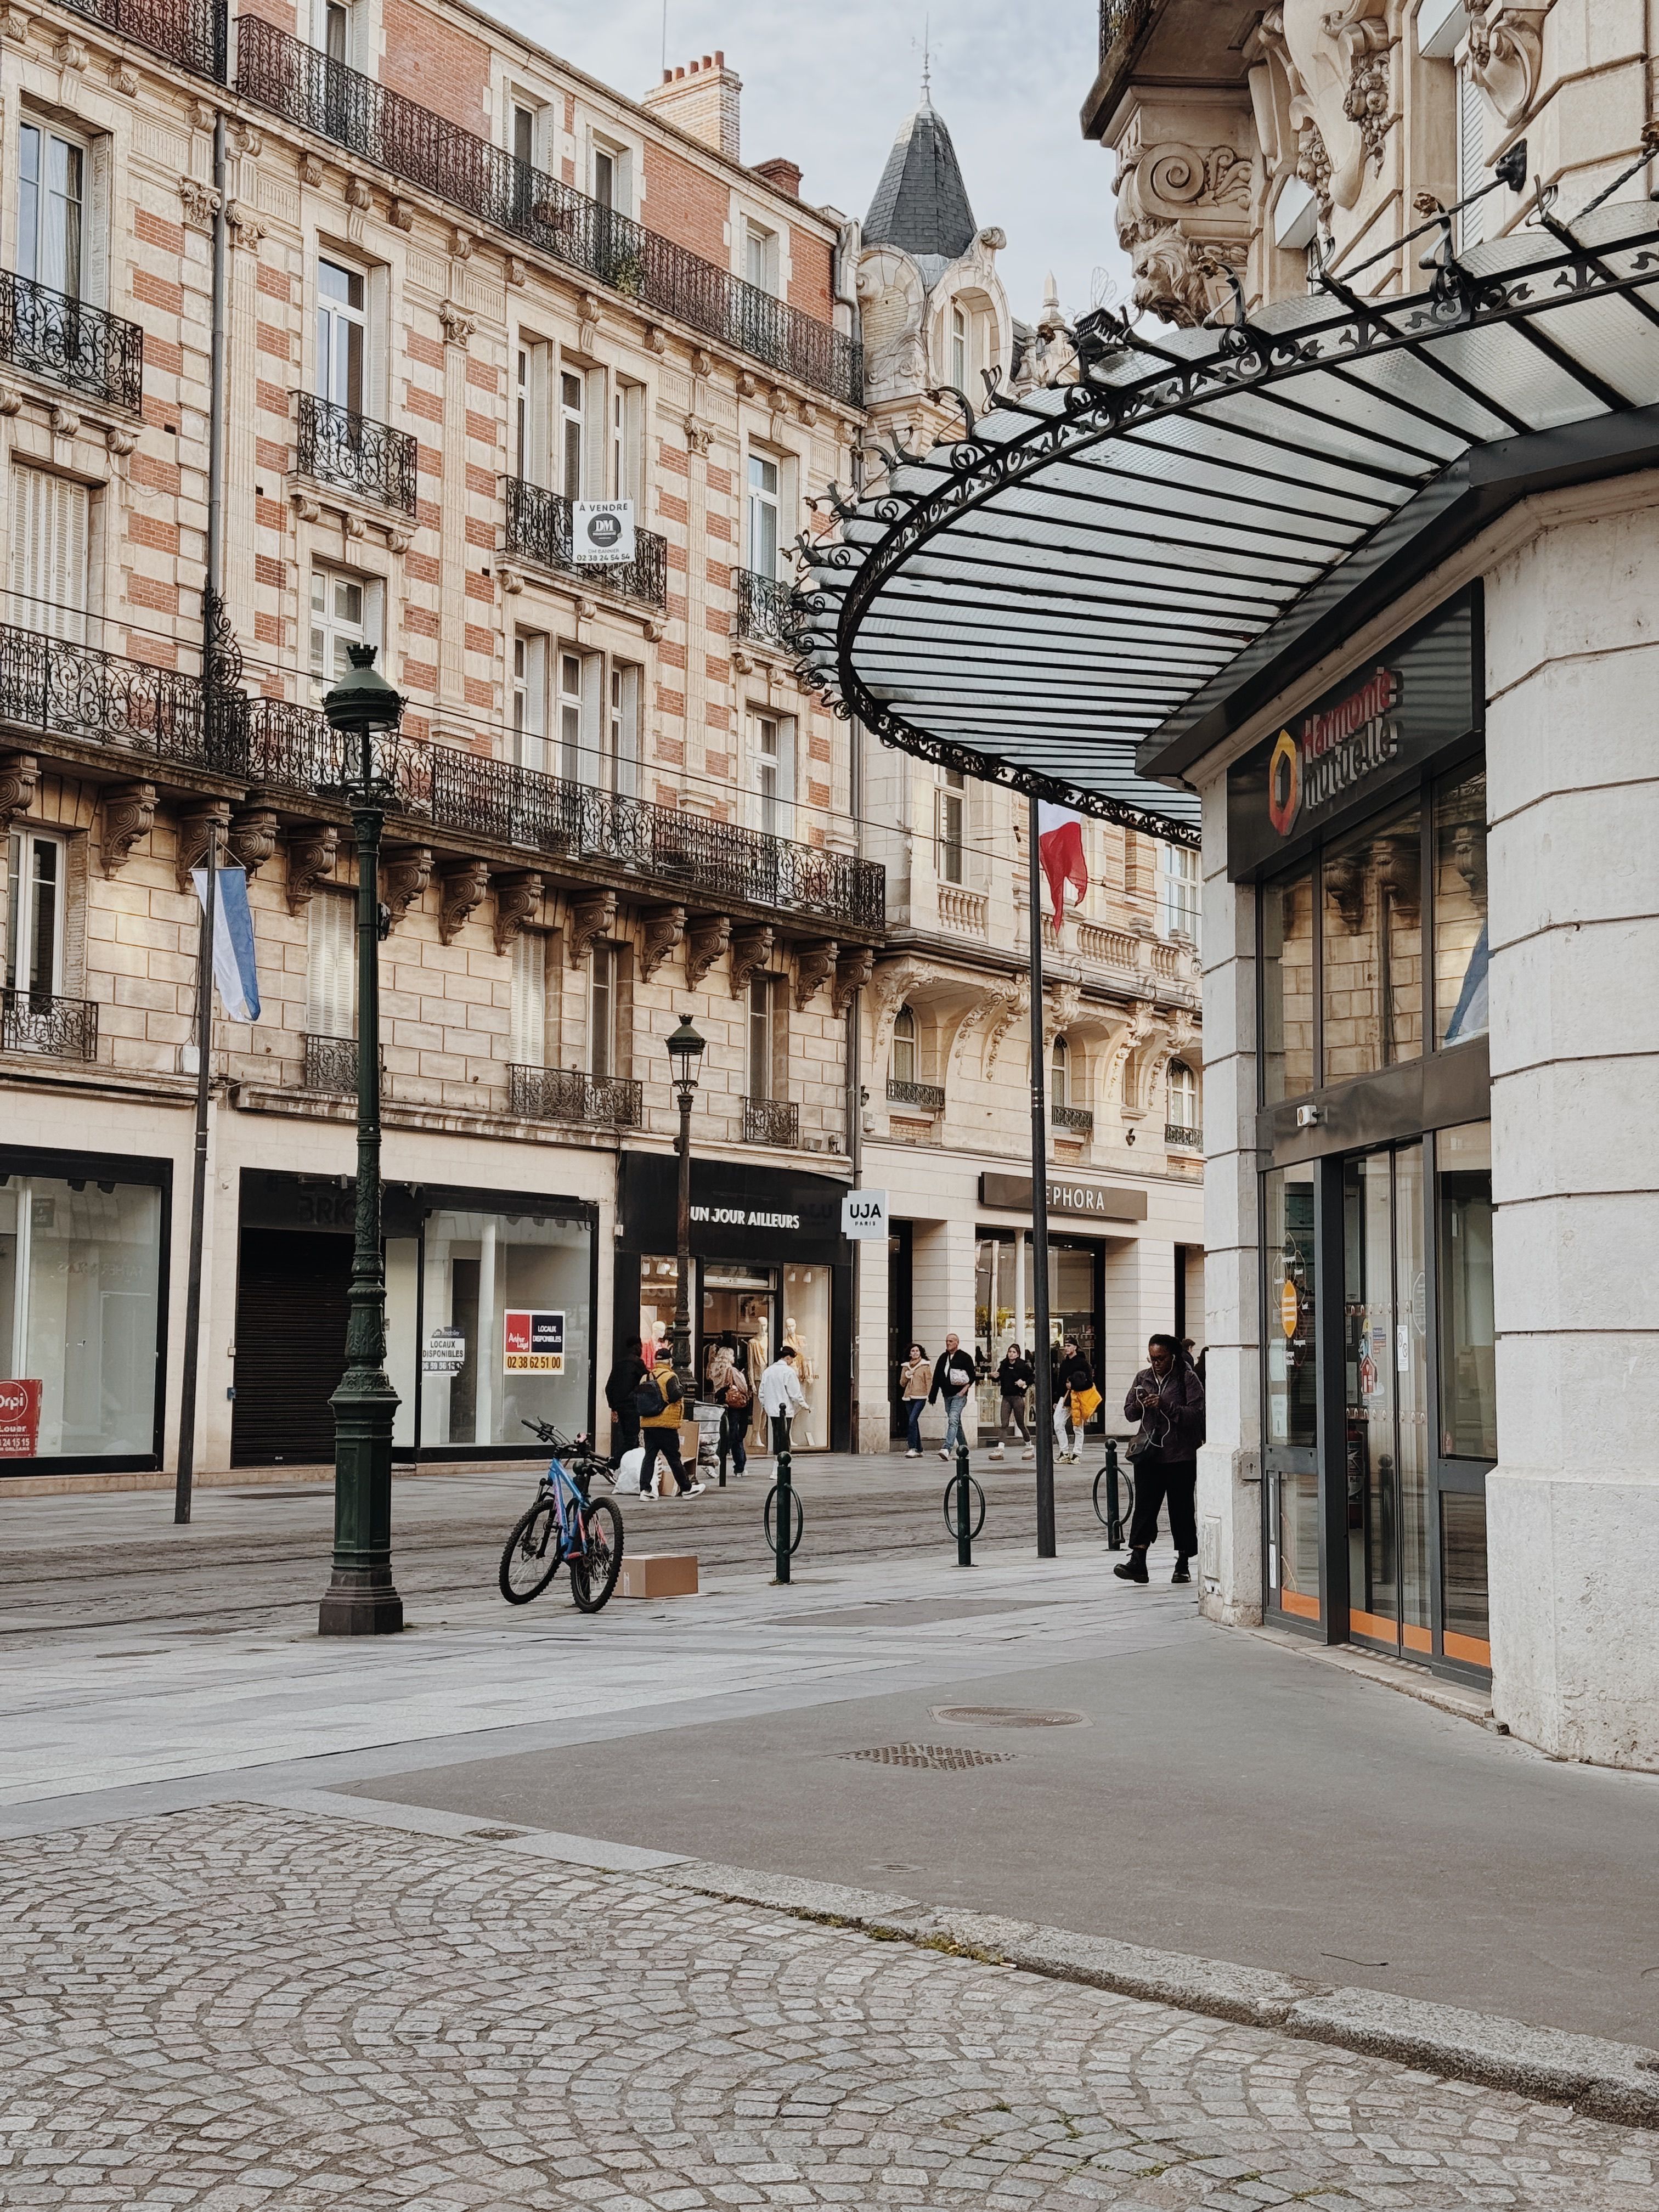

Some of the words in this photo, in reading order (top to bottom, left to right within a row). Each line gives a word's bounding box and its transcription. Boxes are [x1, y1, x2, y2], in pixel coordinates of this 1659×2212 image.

[579, 503, 585, 511] À
[590, 503, 628, 512] VENDRE
[595, 520, 614, 532] DM
[1302, 667, 1397, 763] Harmonie
[1305, 717, 1398, 809] mutuelle
[1046, 1185, 1105, 1211] EPHORA
[690, 1206, 709, 1221] UN
[711, 1208, 745, 1225] JOUR
[747, 1211, 799, 1229] AILLEURS
[850, 1204, 881, 1218] UJA
[422, 1350, 463, 1358] DISPONIBLES
[507, 1356, 517, 1368] 02
[518, 1356, 527, 1368] 38
[530, 1357, 539, 1368] 62
[541, 1357, 549, 1368] 51
[552, 1357, 560, 1368] 00
[3, 1438, 11, 1447] 24
[12, 1438, 20, 1447] 15
[21, 1438, 30, 1447] 15
